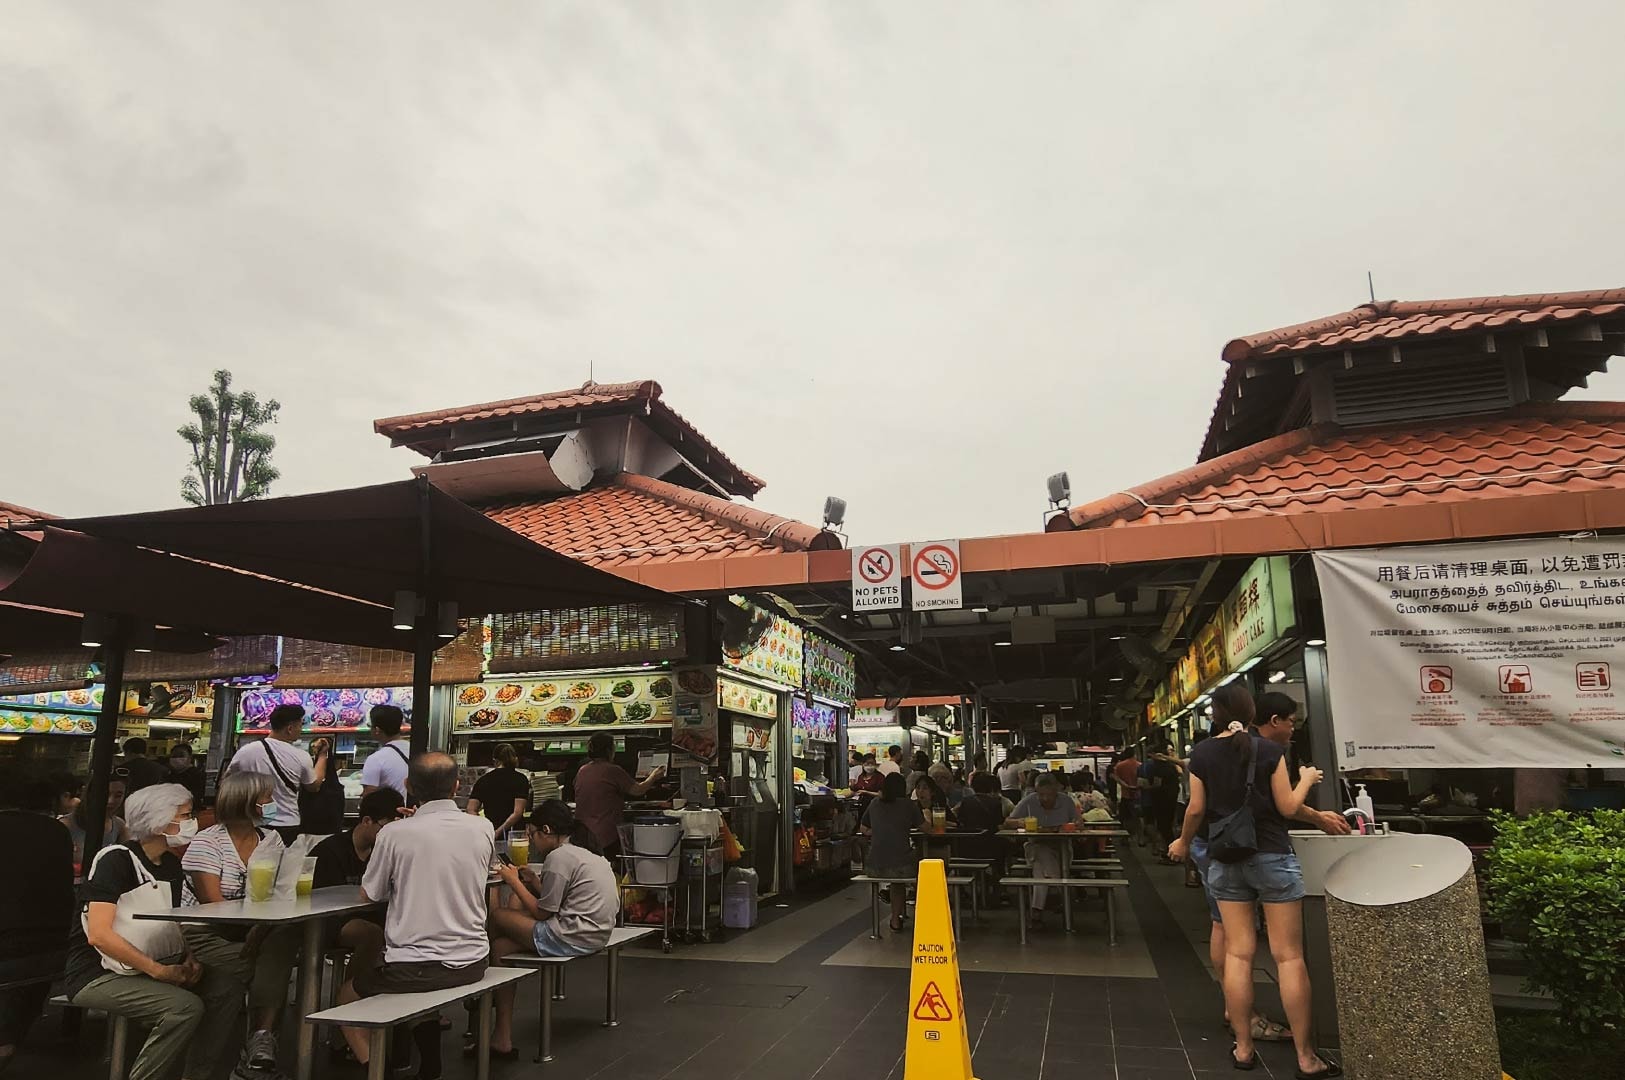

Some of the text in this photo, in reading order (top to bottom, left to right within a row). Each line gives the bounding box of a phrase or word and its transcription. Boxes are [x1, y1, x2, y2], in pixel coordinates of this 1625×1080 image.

[1377, 552, 1625, 582] 用餐后请清理桌面，以免遭罚
[856, 586, 898, 596] NO PETS
[855, 596, 899, 607] ALLOWED
[927, 598, 959, 607] SMOKING
[1250, 617, 1265, 641] CAKE
[918, 944, 944, 952] CAUTION
[914, 956, 948, 964] WET FLOOR
